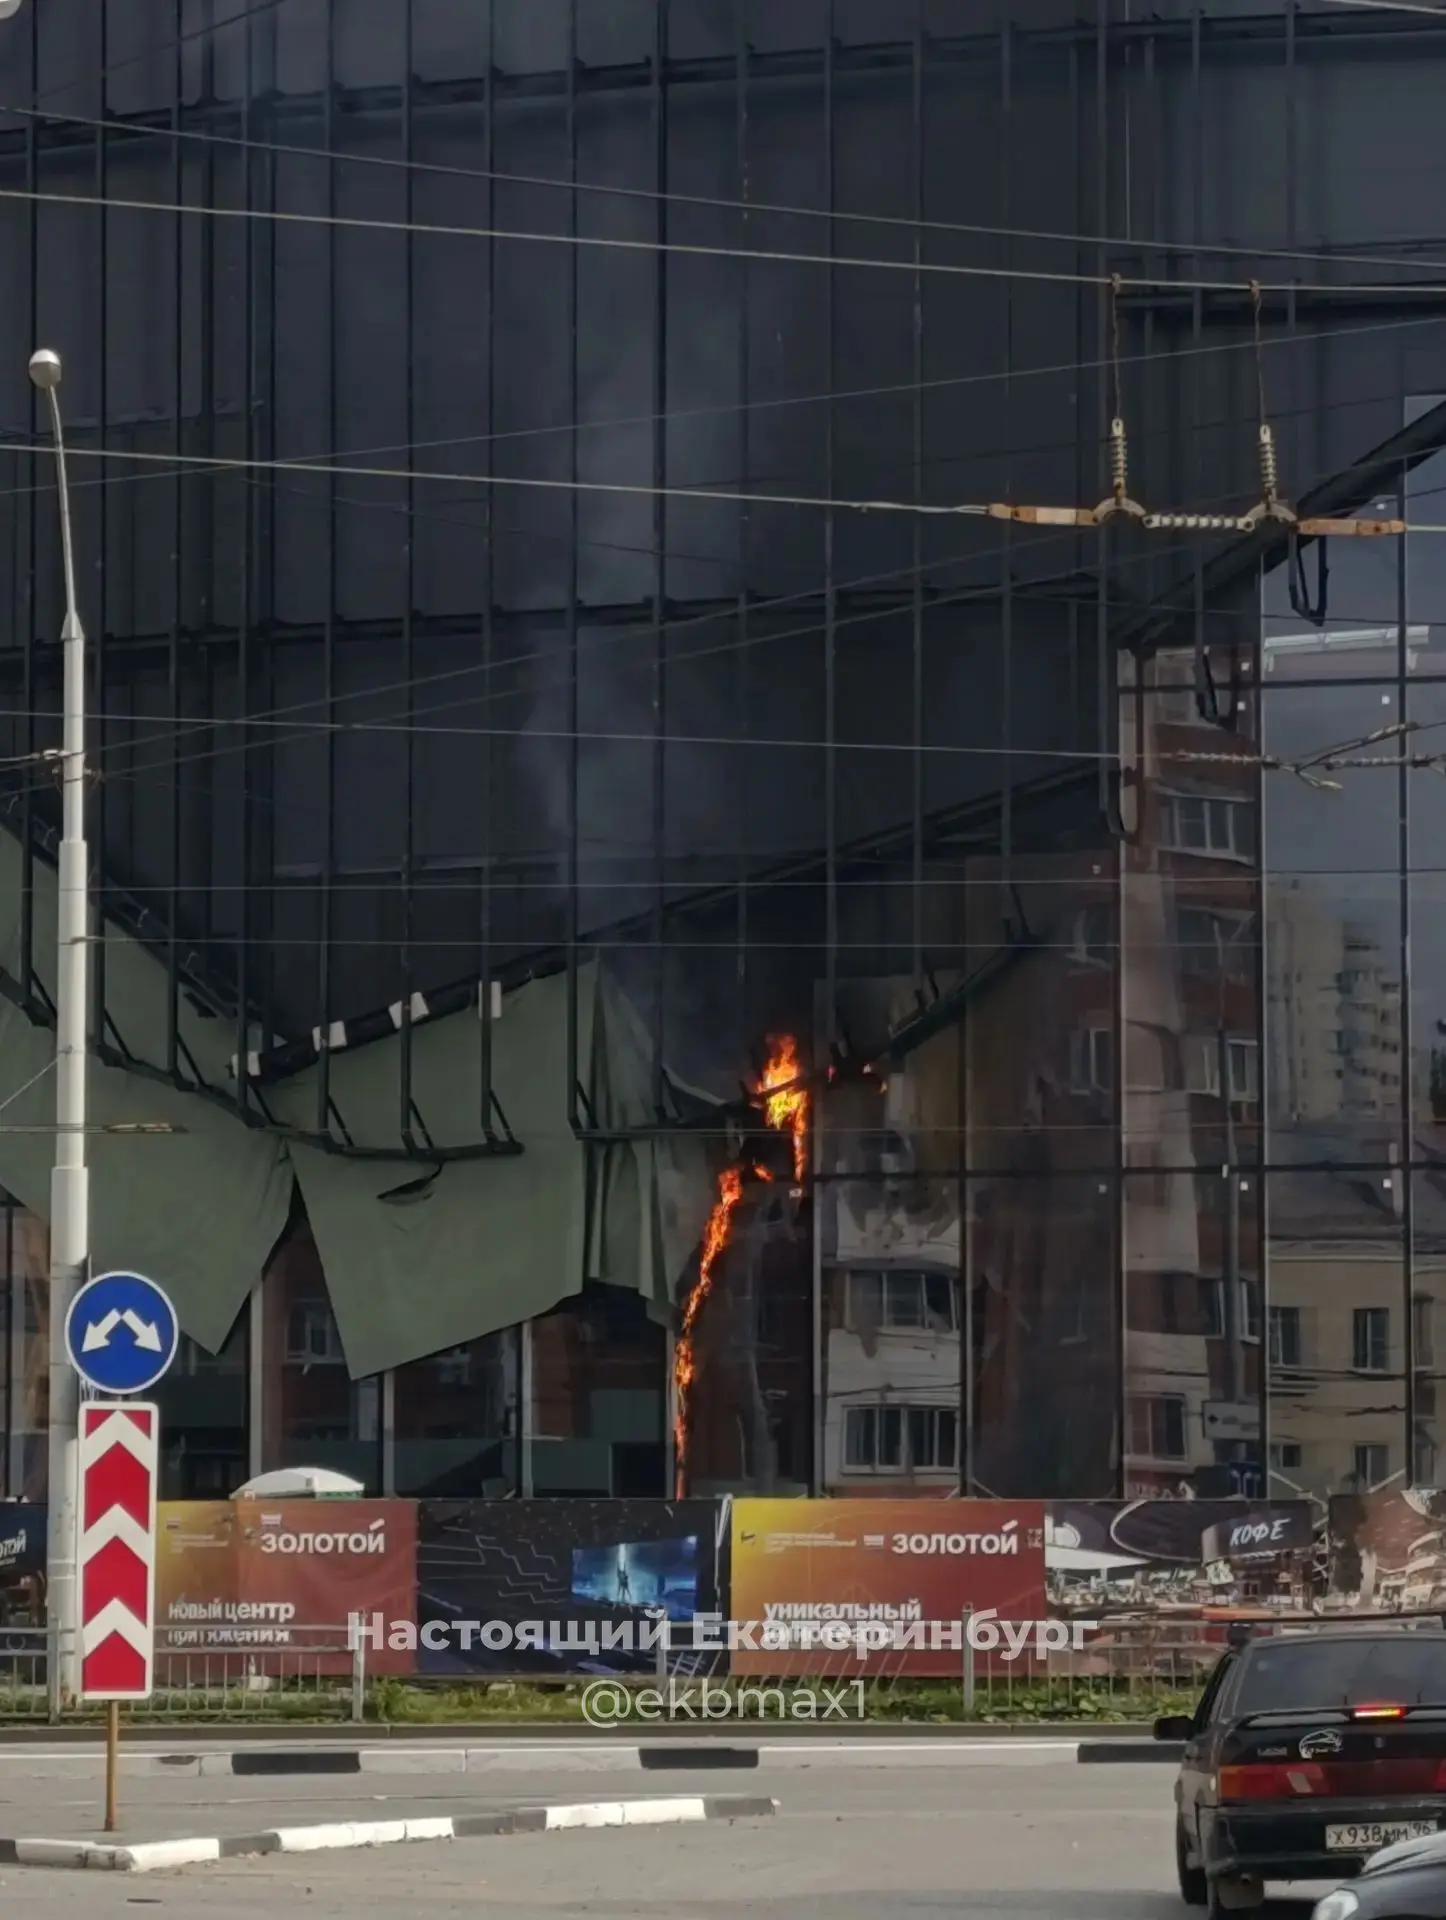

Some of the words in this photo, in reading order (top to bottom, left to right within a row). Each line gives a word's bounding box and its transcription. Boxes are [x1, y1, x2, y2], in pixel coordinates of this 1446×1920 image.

[1229, 1518, 1291, 1546] КОФЕ
[168, 1597, 222, 1620] новый
[224, 1602, 295, 1623] центр
[764, 1598, 921, 1621] уникальный
